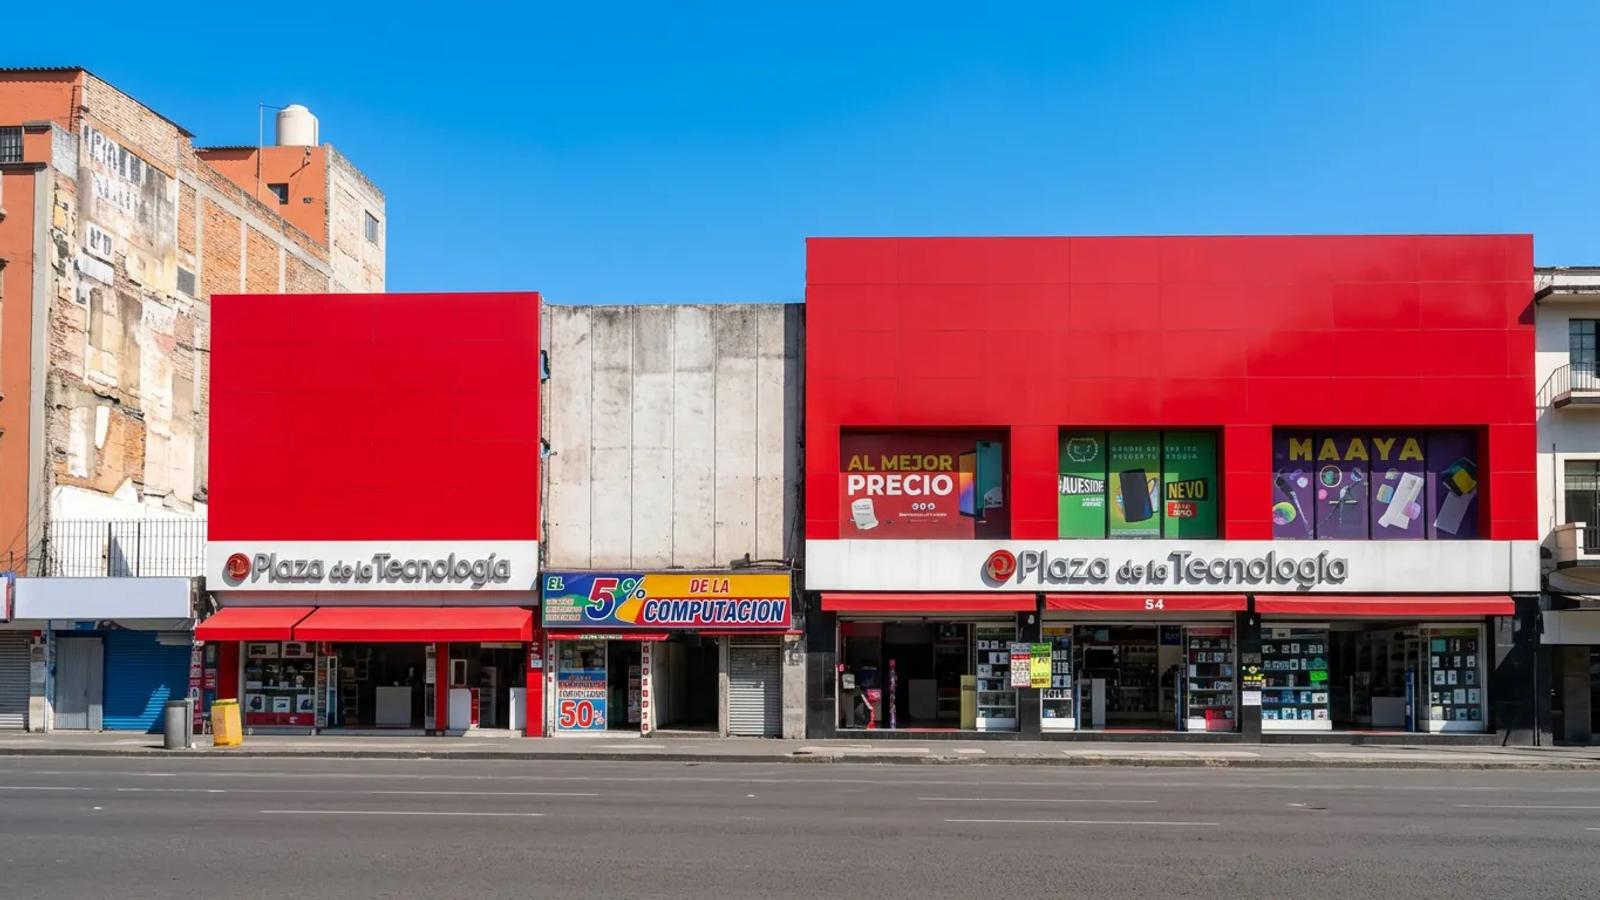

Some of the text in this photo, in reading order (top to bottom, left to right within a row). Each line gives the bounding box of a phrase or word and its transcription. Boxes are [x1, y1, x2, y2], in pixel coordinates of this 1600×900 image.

[1289, 437, 1424, 461] MAAYA
[848, 455, 953, 471] AL MEJOR
[847, 474, 953, 496] PRECIO
[1168, 480, 1204, 498] NEVO
[251, 552, 325, 582] Plaza
[355, 560, 373, 583] la
[372, 552, 511, 588] Tecnología
[1018, 550, 1349, 590] Plaza de la Tecnología
[547, 576, 565, 591] EL
[690, 577, 729, 595] DE LA
[644, 599, 787, 624] COMPUTACION
[1145, 599, 1164, 610] S4
